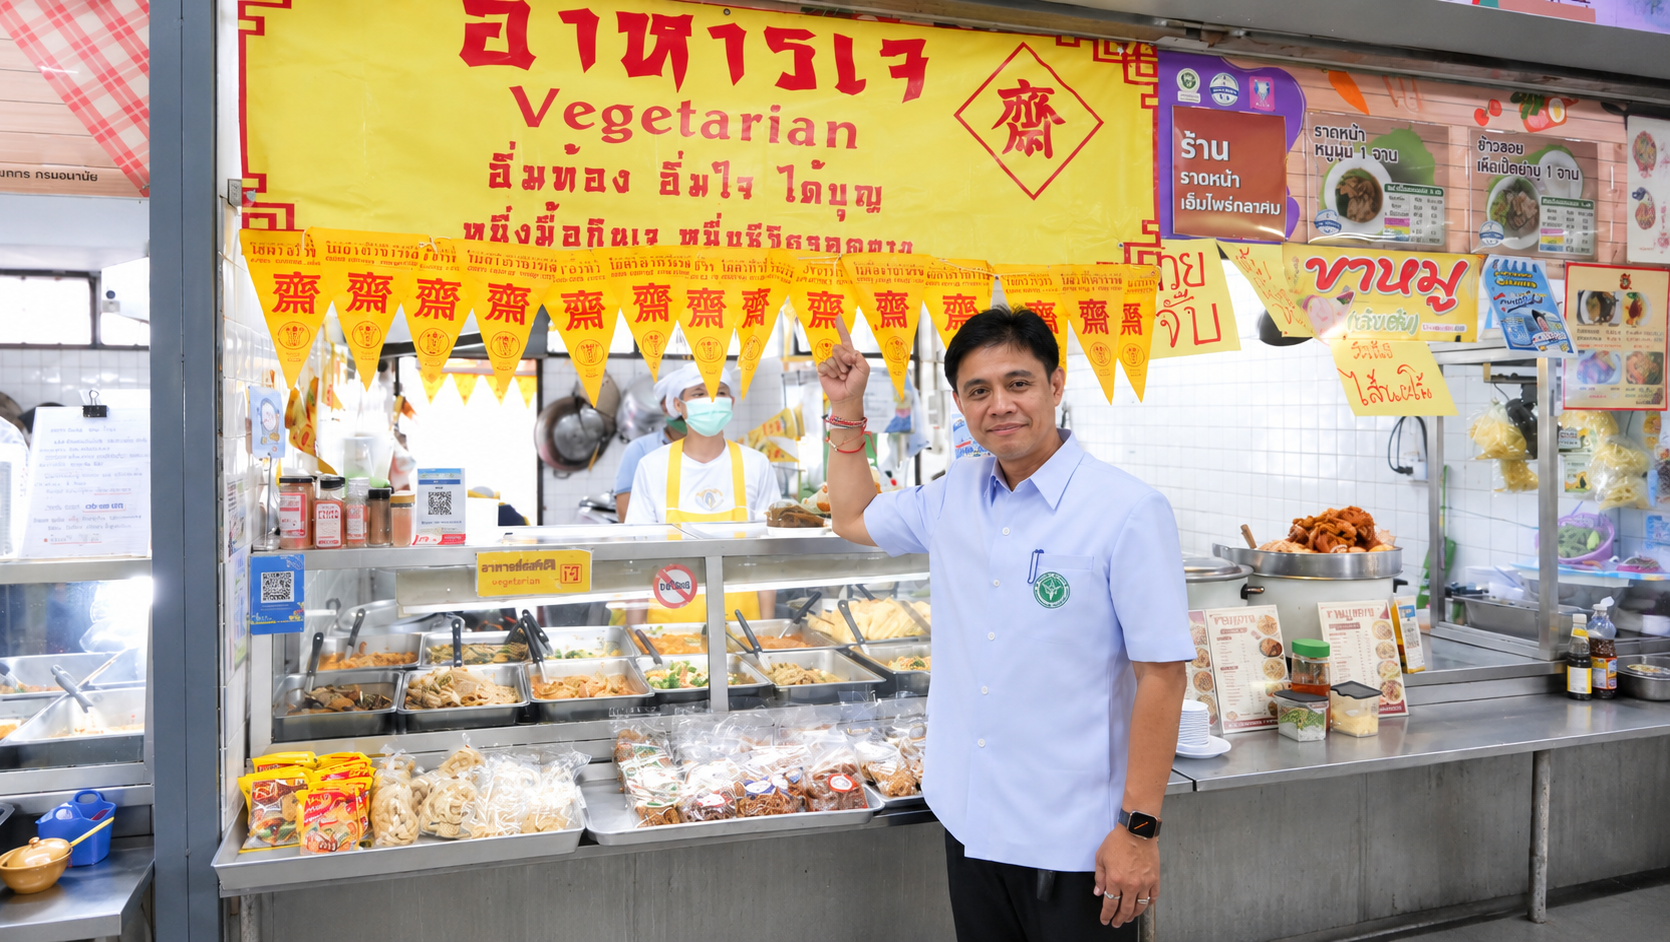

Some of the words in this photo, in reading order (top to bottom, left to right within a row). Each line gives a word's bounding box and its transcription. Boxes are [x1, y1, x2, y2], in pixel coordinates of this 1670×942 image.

[459, 0, 929, 104] อาหารเจ
[509, 85, 858, 150] Vegetarian
[991, 79, 1066, 159] 齋
[1180, 130, 1230, 161] ร้าน
[489, 140, 630, 193] อิ่มท้อง
[659, 151, 753, 200] อิ่มใจ
[777, 160, 882, 222] ได้บุญ
[1360, 146, 1366, 159] 1
[1372, 148, 1398, 162] จาน
[1546, 165, 1551, 178] 1
[1557, 168, 1580, 180] จาน
[1305, 257, 1468, 313] ขาหมู
